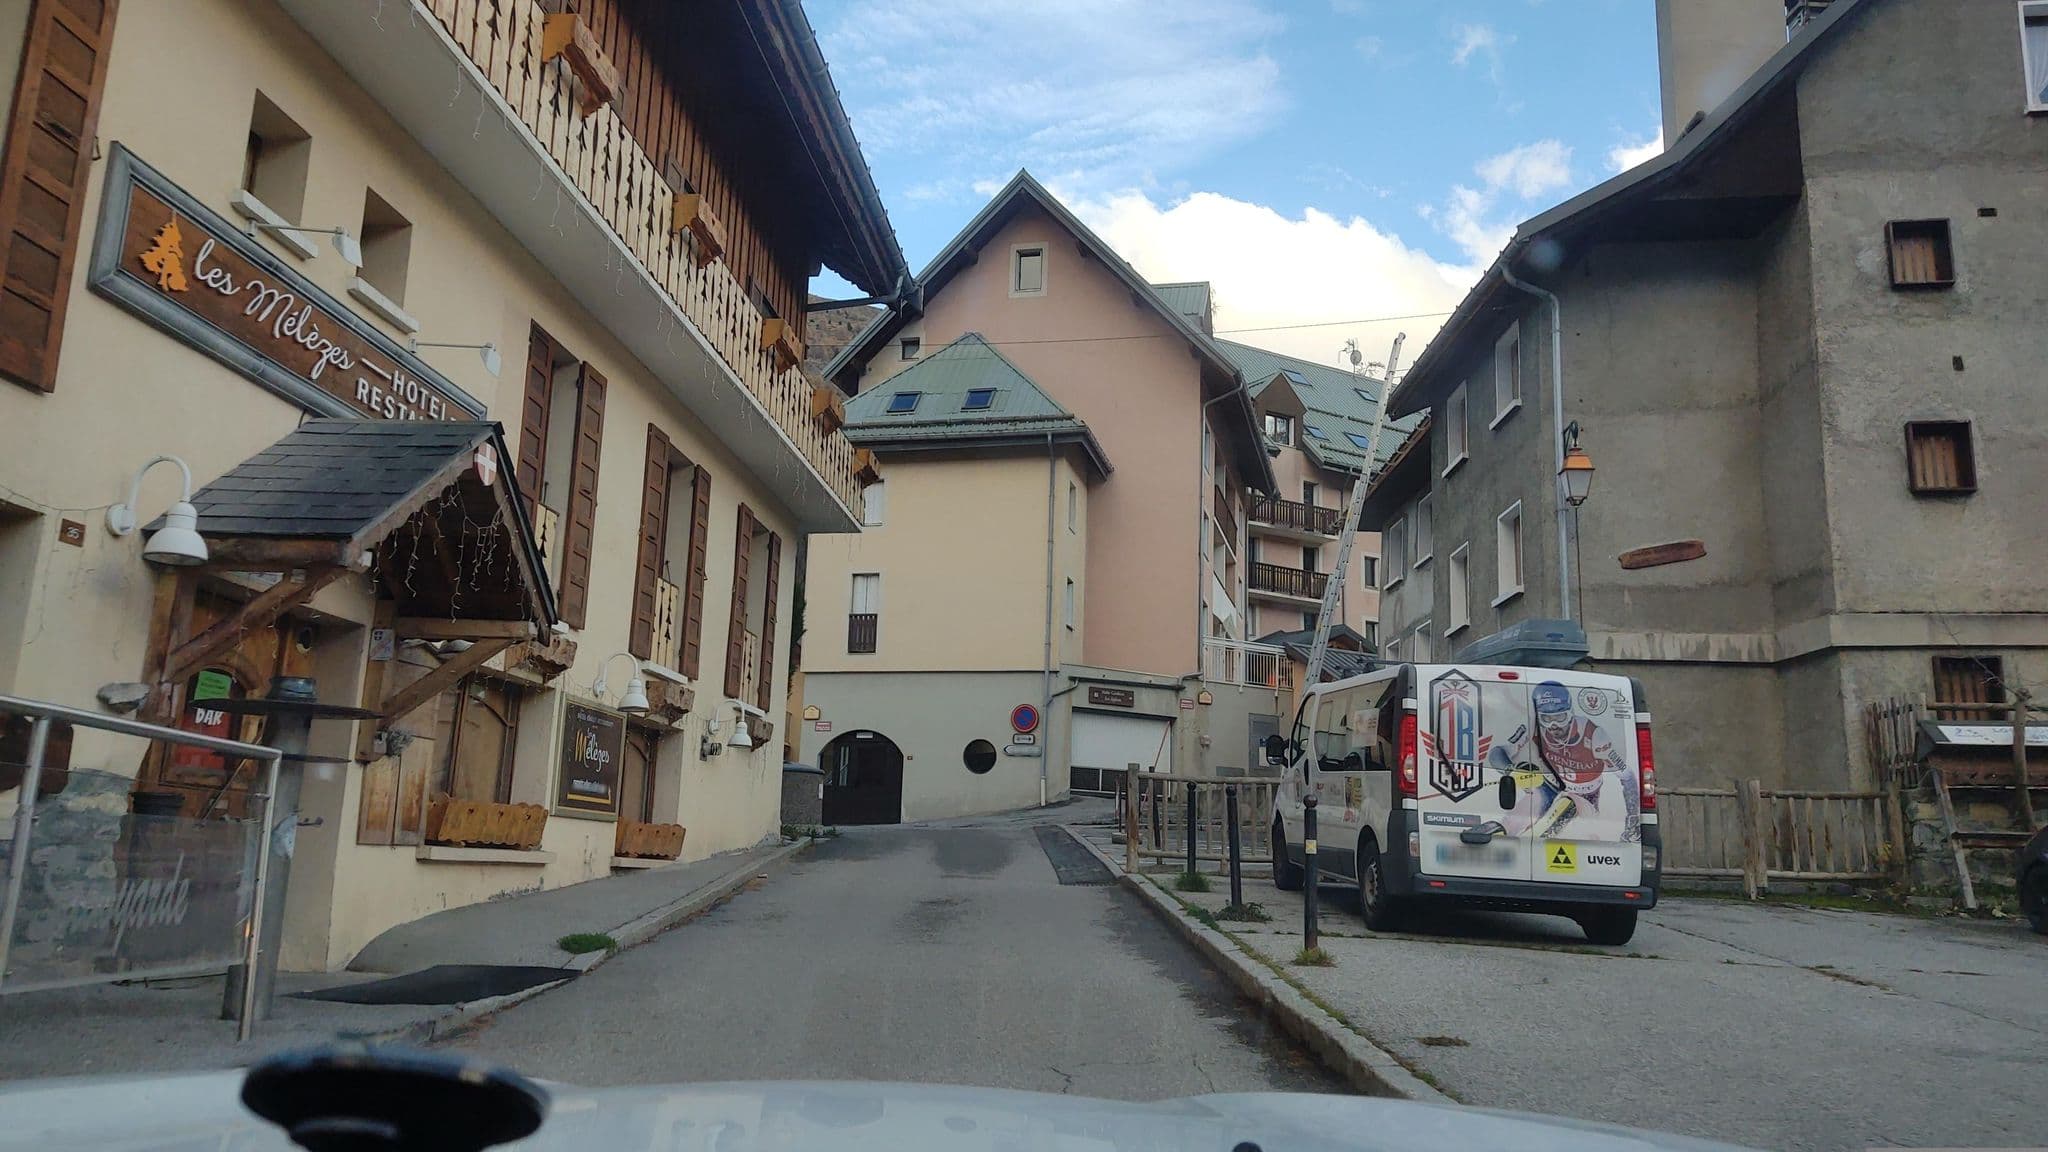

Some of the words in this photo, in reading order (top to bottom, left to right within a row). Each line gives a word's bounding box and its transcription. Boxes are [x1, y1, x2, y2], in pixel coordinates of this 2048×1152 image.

[194, 238, 240, 295] les
[245, 280, 355, 380] Mélèzes
[1587, 855, 1621, 866] uvex
